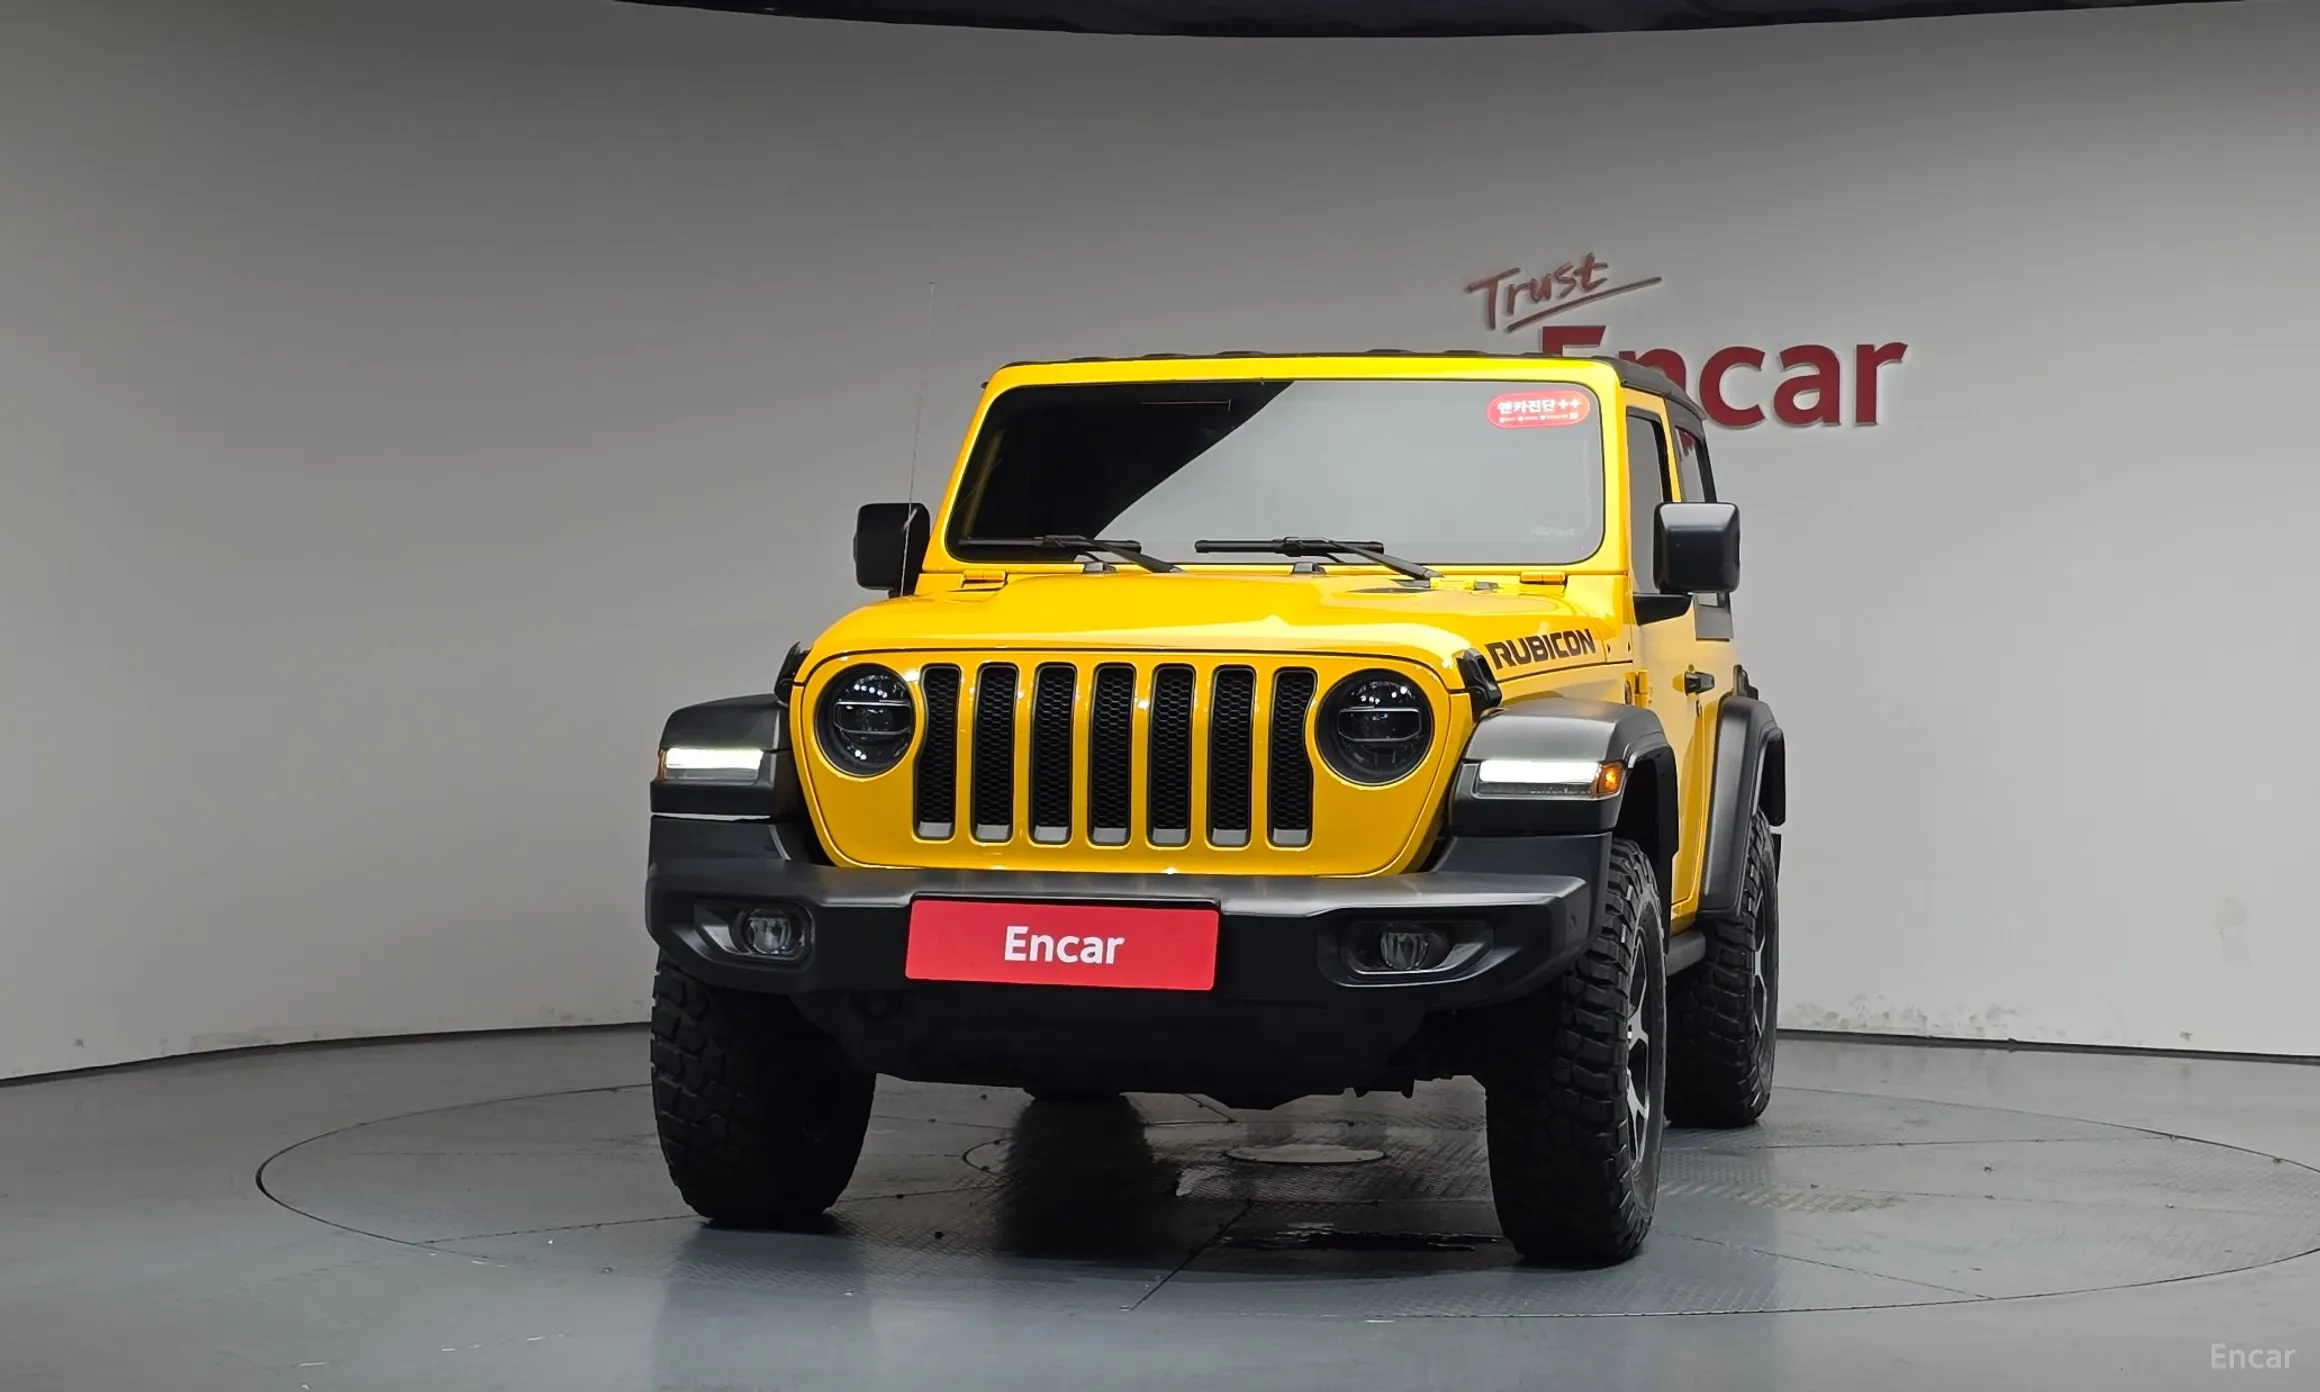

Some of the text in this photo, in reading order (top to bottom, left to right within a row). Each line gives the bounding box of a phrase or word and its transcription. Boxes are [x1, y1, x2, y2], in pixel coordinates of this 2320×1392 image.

[1466, 251, 1609, 330] Trust
[1484, 628, 1596, 670] RUBICON
[1004, 925, 1125, 964] Encar
